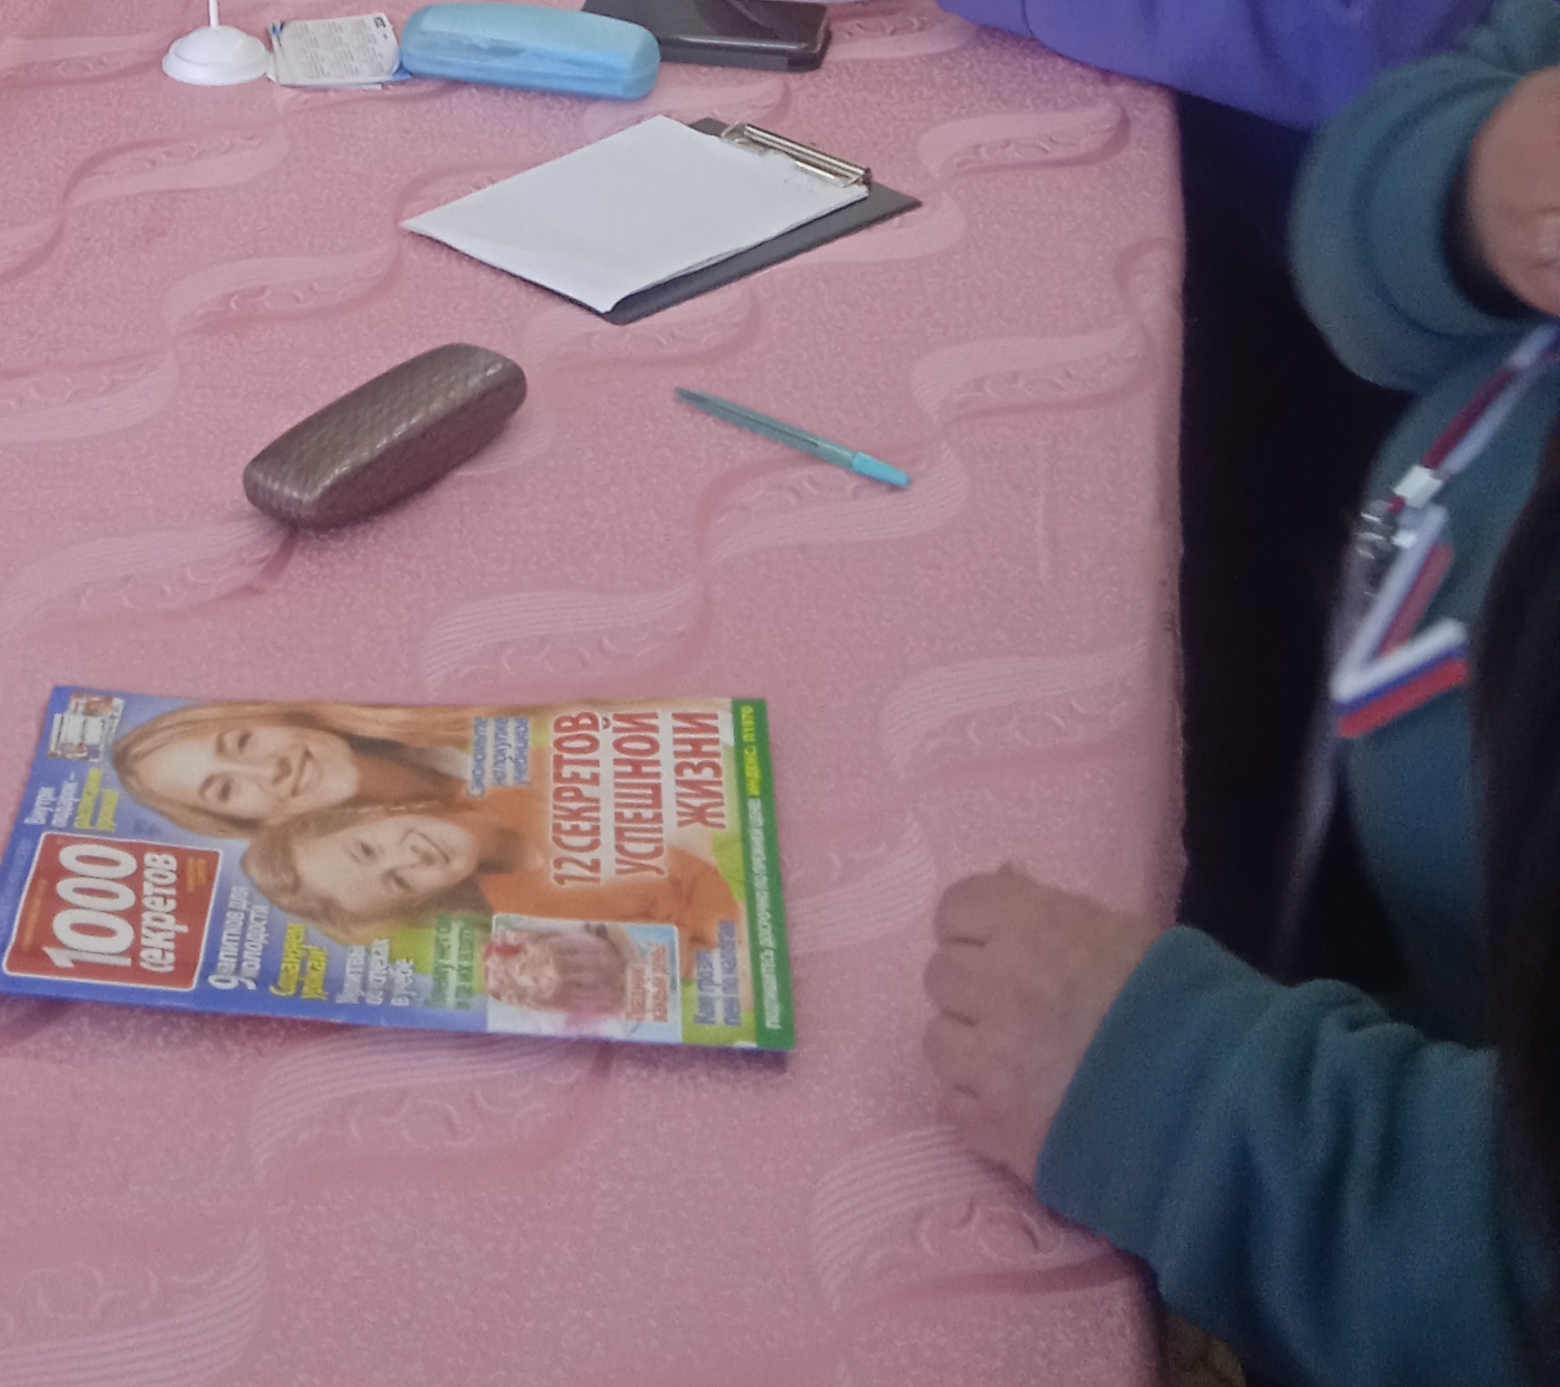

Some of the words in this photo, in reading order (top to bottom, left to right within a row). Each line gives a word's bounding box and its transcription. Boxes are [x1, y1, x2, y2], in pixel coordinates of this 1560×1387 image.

[552, 712, 601, 854] СЕКРЕТОВ
[602, 711, 666, 875] УСПЕШНОЙ
[673, 712, 725, 828] ЖИЗНИ
[41, 843, 138, 968] 1000
[552, 856, 601, 887] 12
[208, 975, 258, 991] 9
